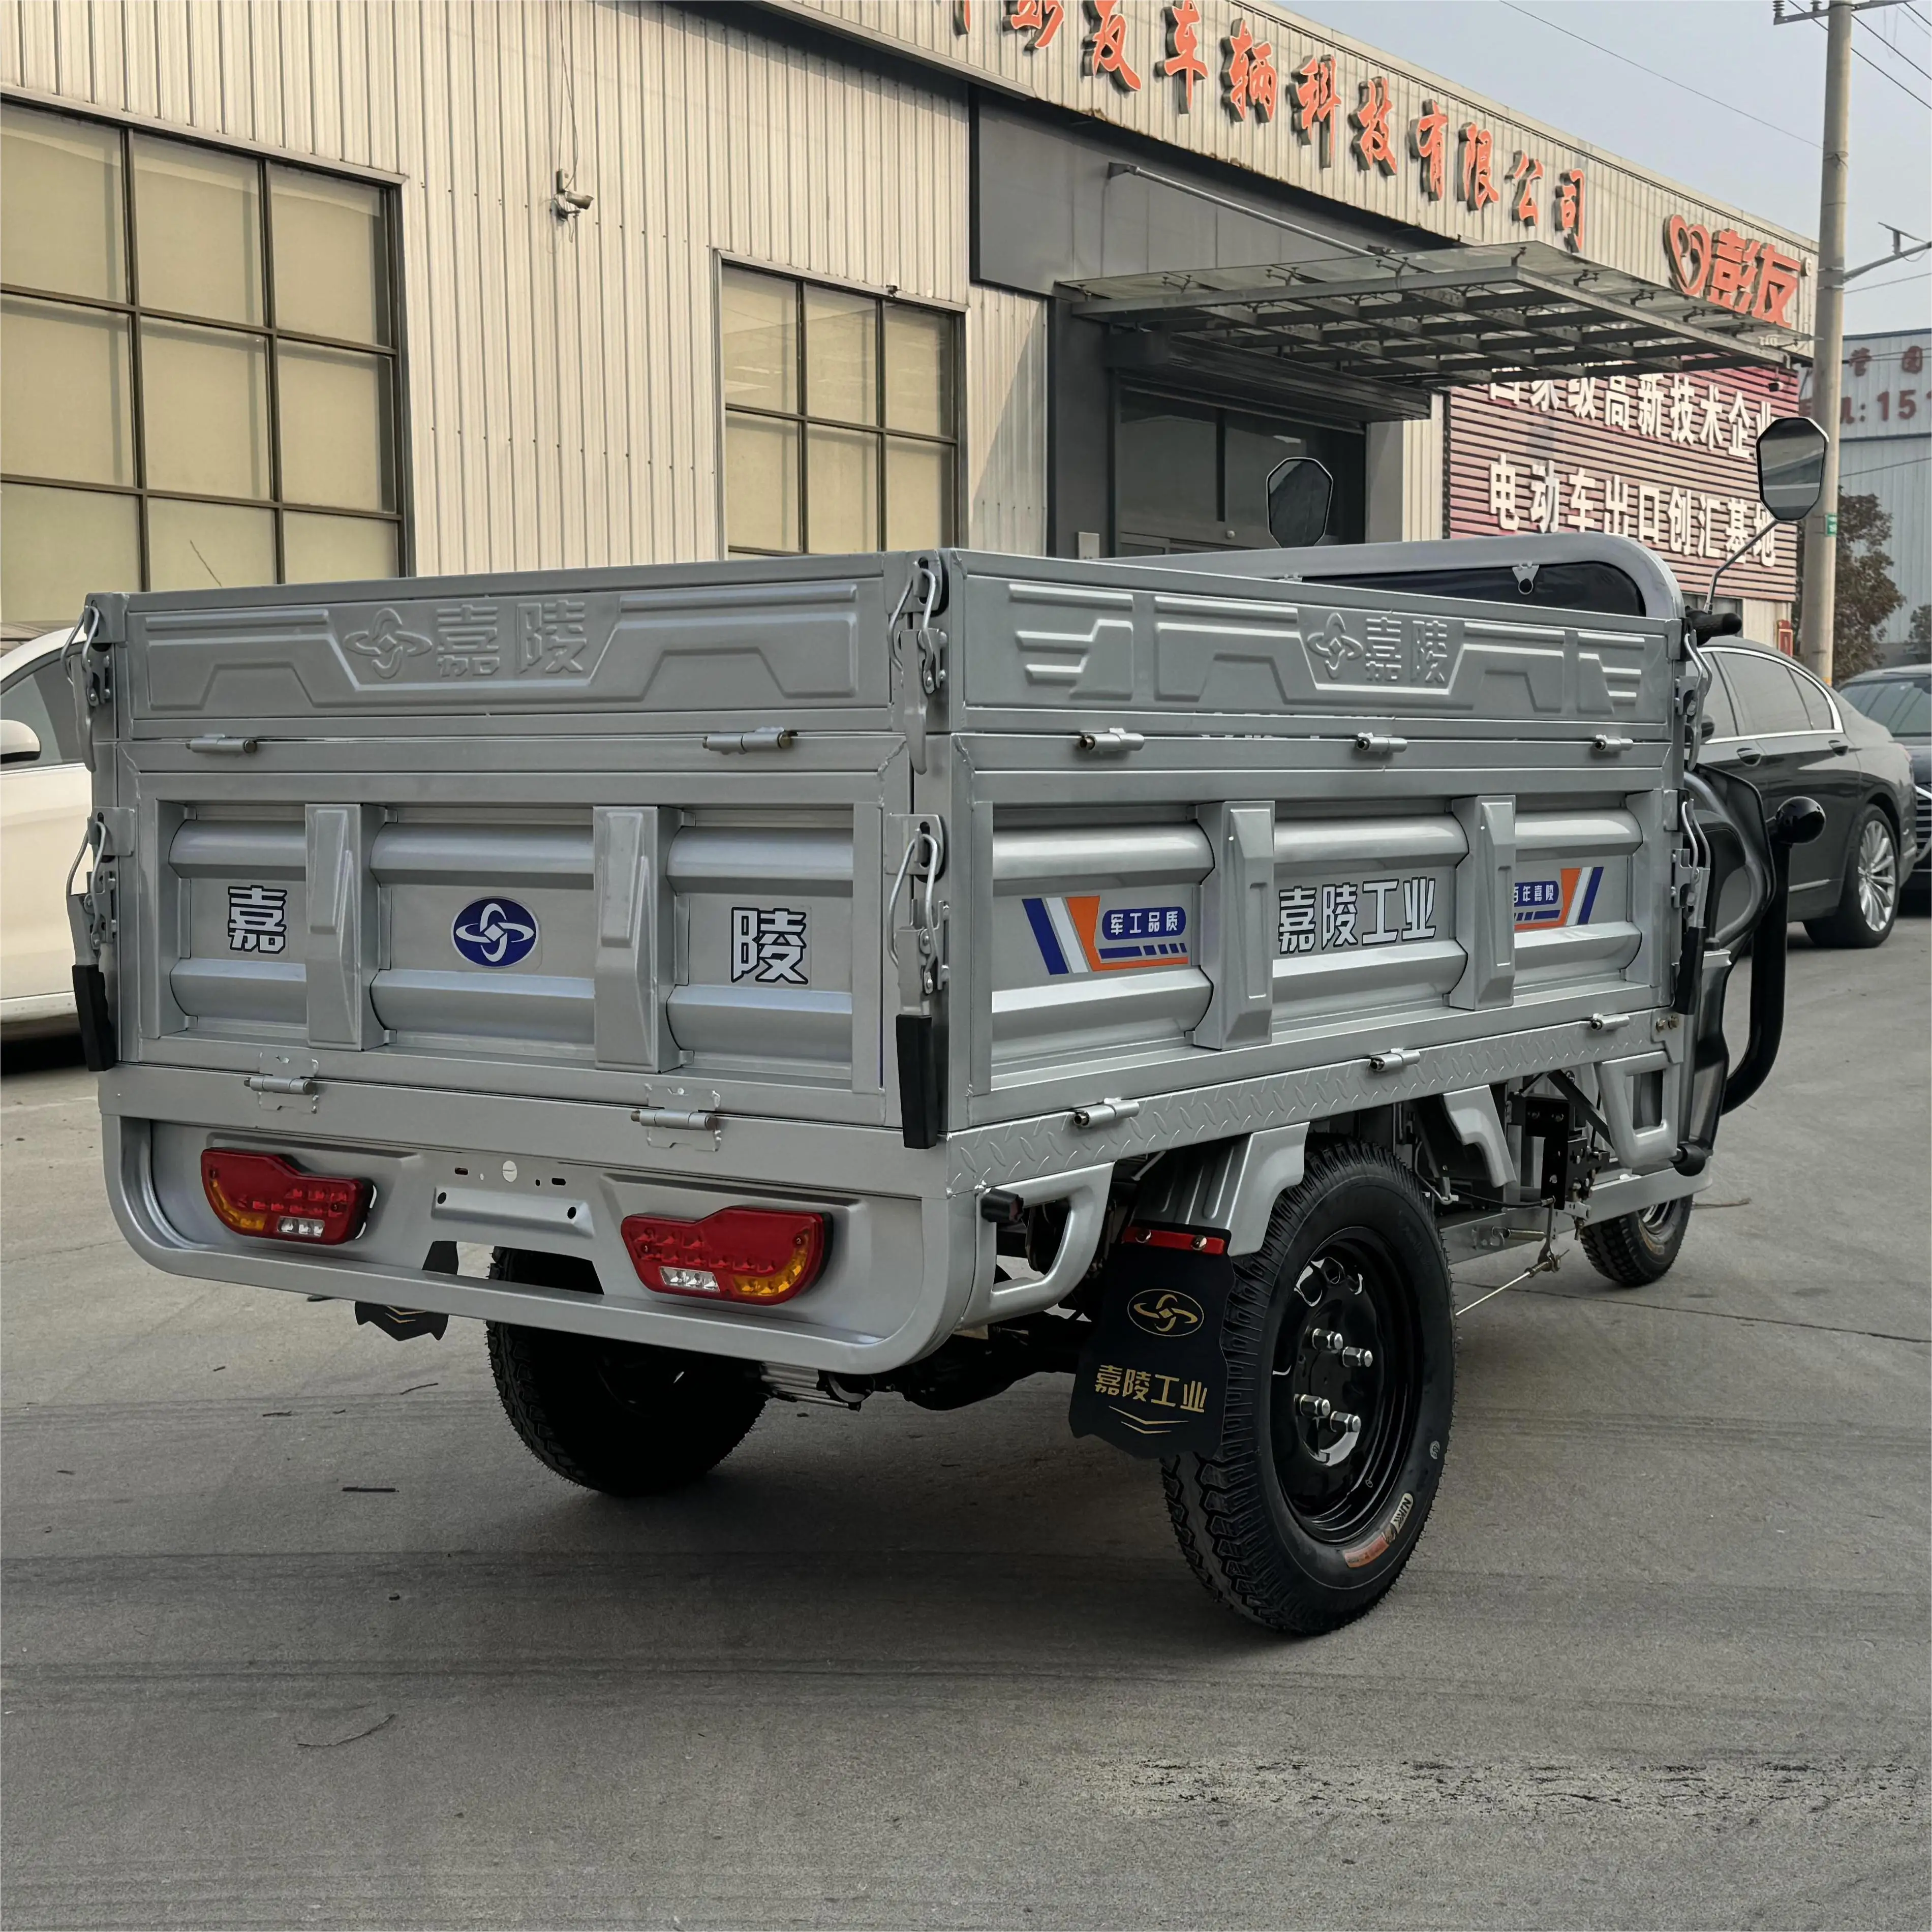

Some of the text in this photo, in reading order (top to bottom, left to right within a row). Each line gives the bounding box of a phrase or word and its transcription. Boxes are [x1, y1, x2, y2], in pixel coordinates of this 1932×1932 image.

[1708, 228, 1801, 328] 彭友
[1489, 453, 1776, 567] 电动车出口创汇基地
[437, 600, 587, 678] 嘉陵
[1365, 617, 1448, 683] 嘉陵
[227, 885, 809, 986] 嘉 陵
[1110, 910, 1179, 935] 军工品质
[1278, 876, 1437, 955] 嘉陵工业
[1094, 1364, 1208, 1414] 嘉陵工业
